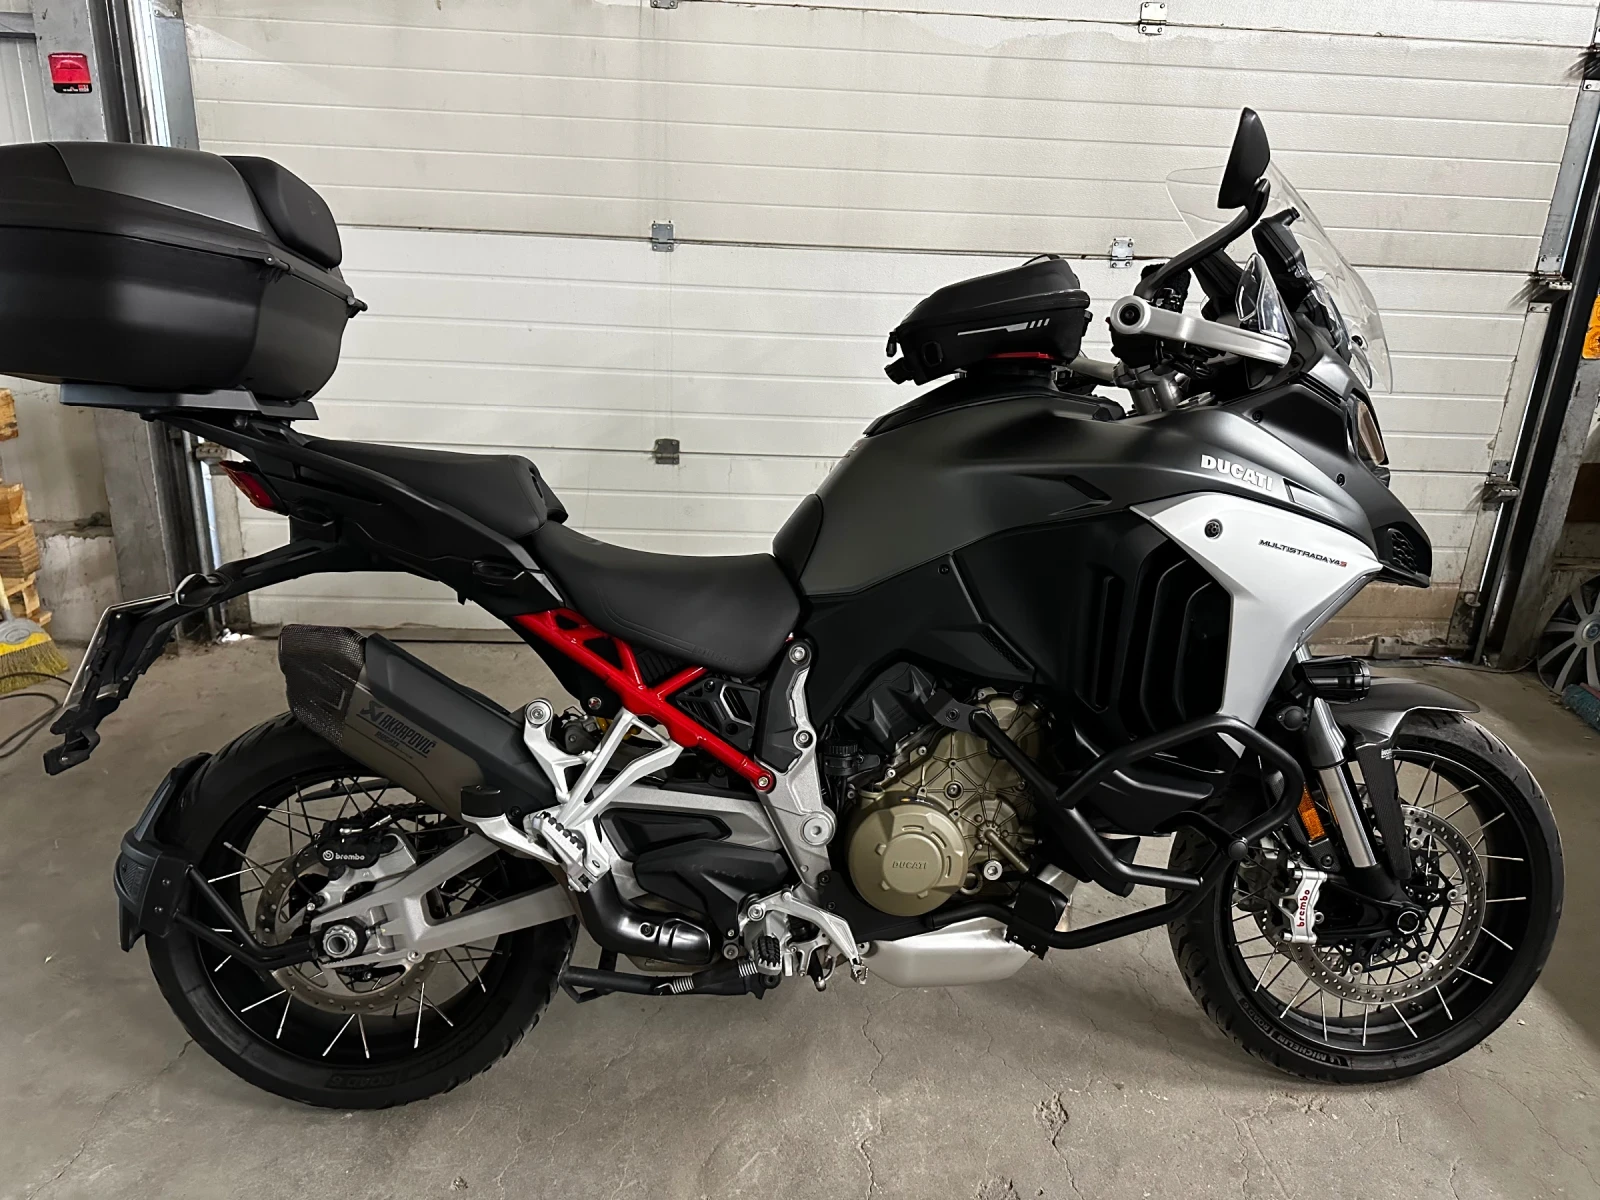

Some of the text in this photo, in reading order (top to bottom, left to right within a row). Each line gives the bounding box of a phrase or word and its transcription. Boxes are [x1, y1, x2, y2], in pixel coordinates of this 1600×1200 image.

[1200, 454, 1273, 491] DUCATI
[1258, 539, 1328, 564] MULTISTRADA
[335, 852, 365, 860] brembo
[892, 861, 927, 870] DUCATI
[1296, 889, 1310, 927] brembo
[1248, 1010, 1271, 1031] ROAD
[1277, 1035, 1327, 1062] MICHELIN
